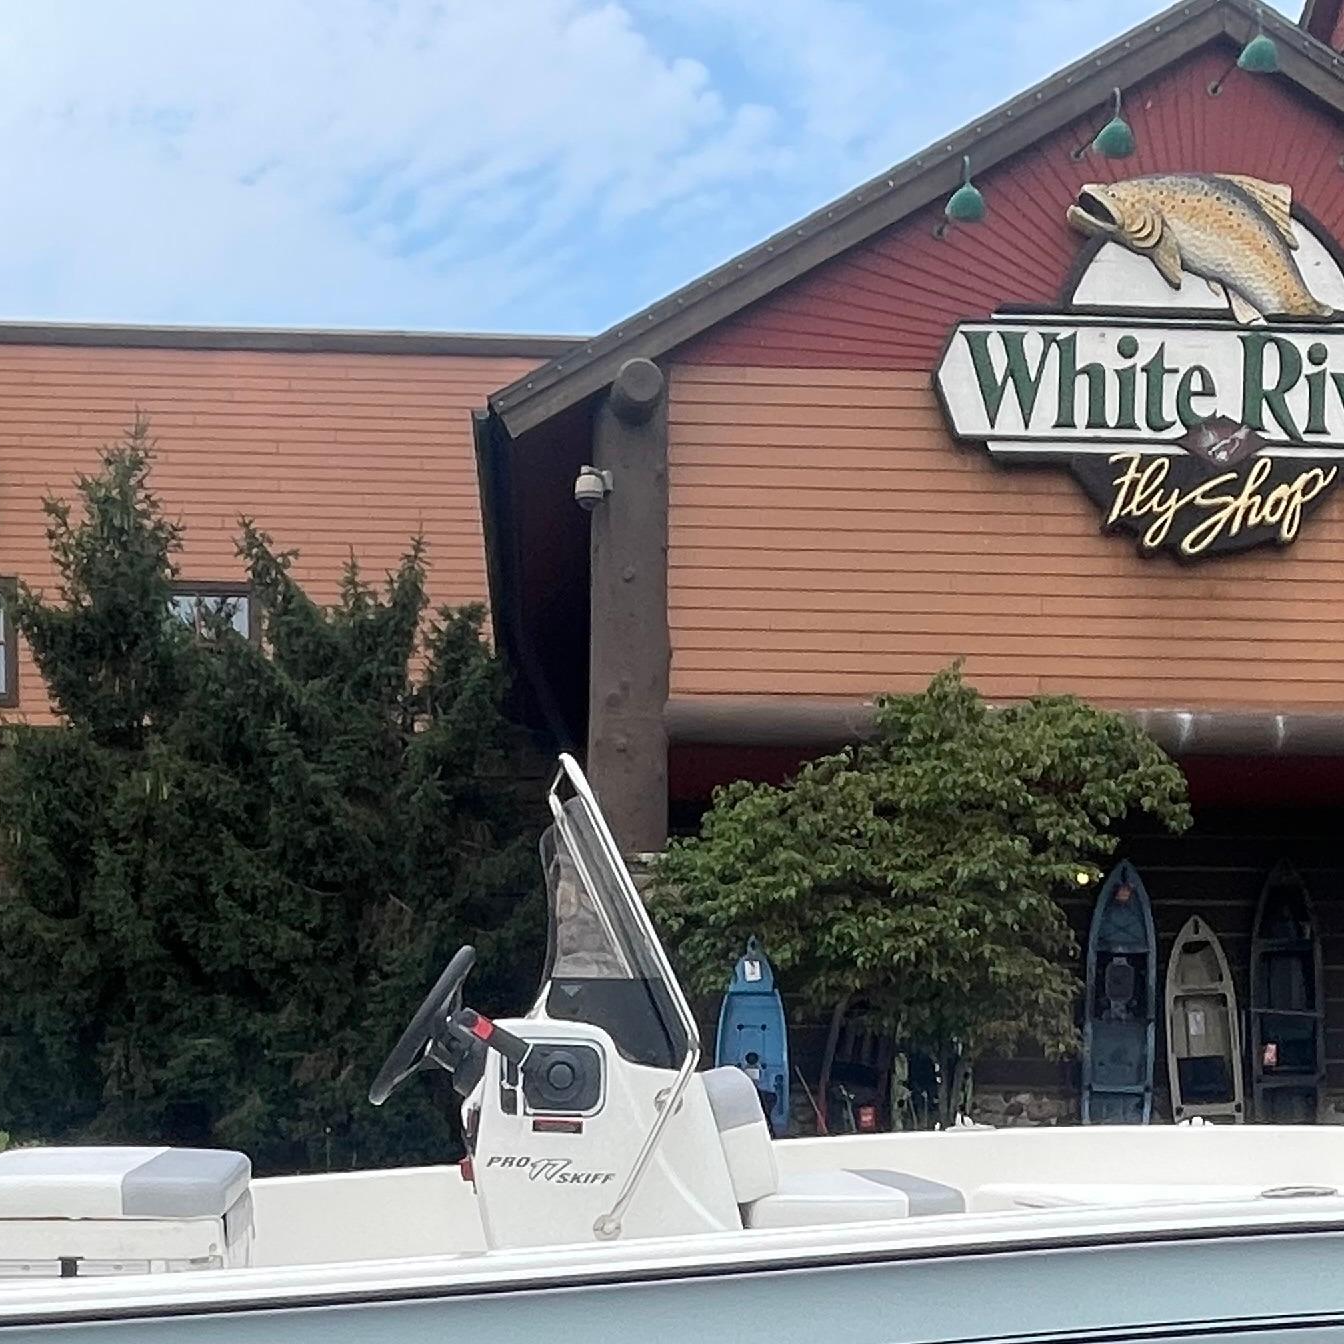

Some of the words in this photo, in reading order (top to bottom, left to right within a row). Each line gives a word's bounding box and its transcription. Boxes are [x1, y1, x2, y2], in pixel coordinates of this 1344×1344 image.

[960, 328, 1217, 432] White
[1106, 452, 1189, 549] Fly
[1180, 456, 1338, 556] Shop
[486, 1156, 531, 1168] PRO
[555, 1172, 616, 1185] SKIFF
